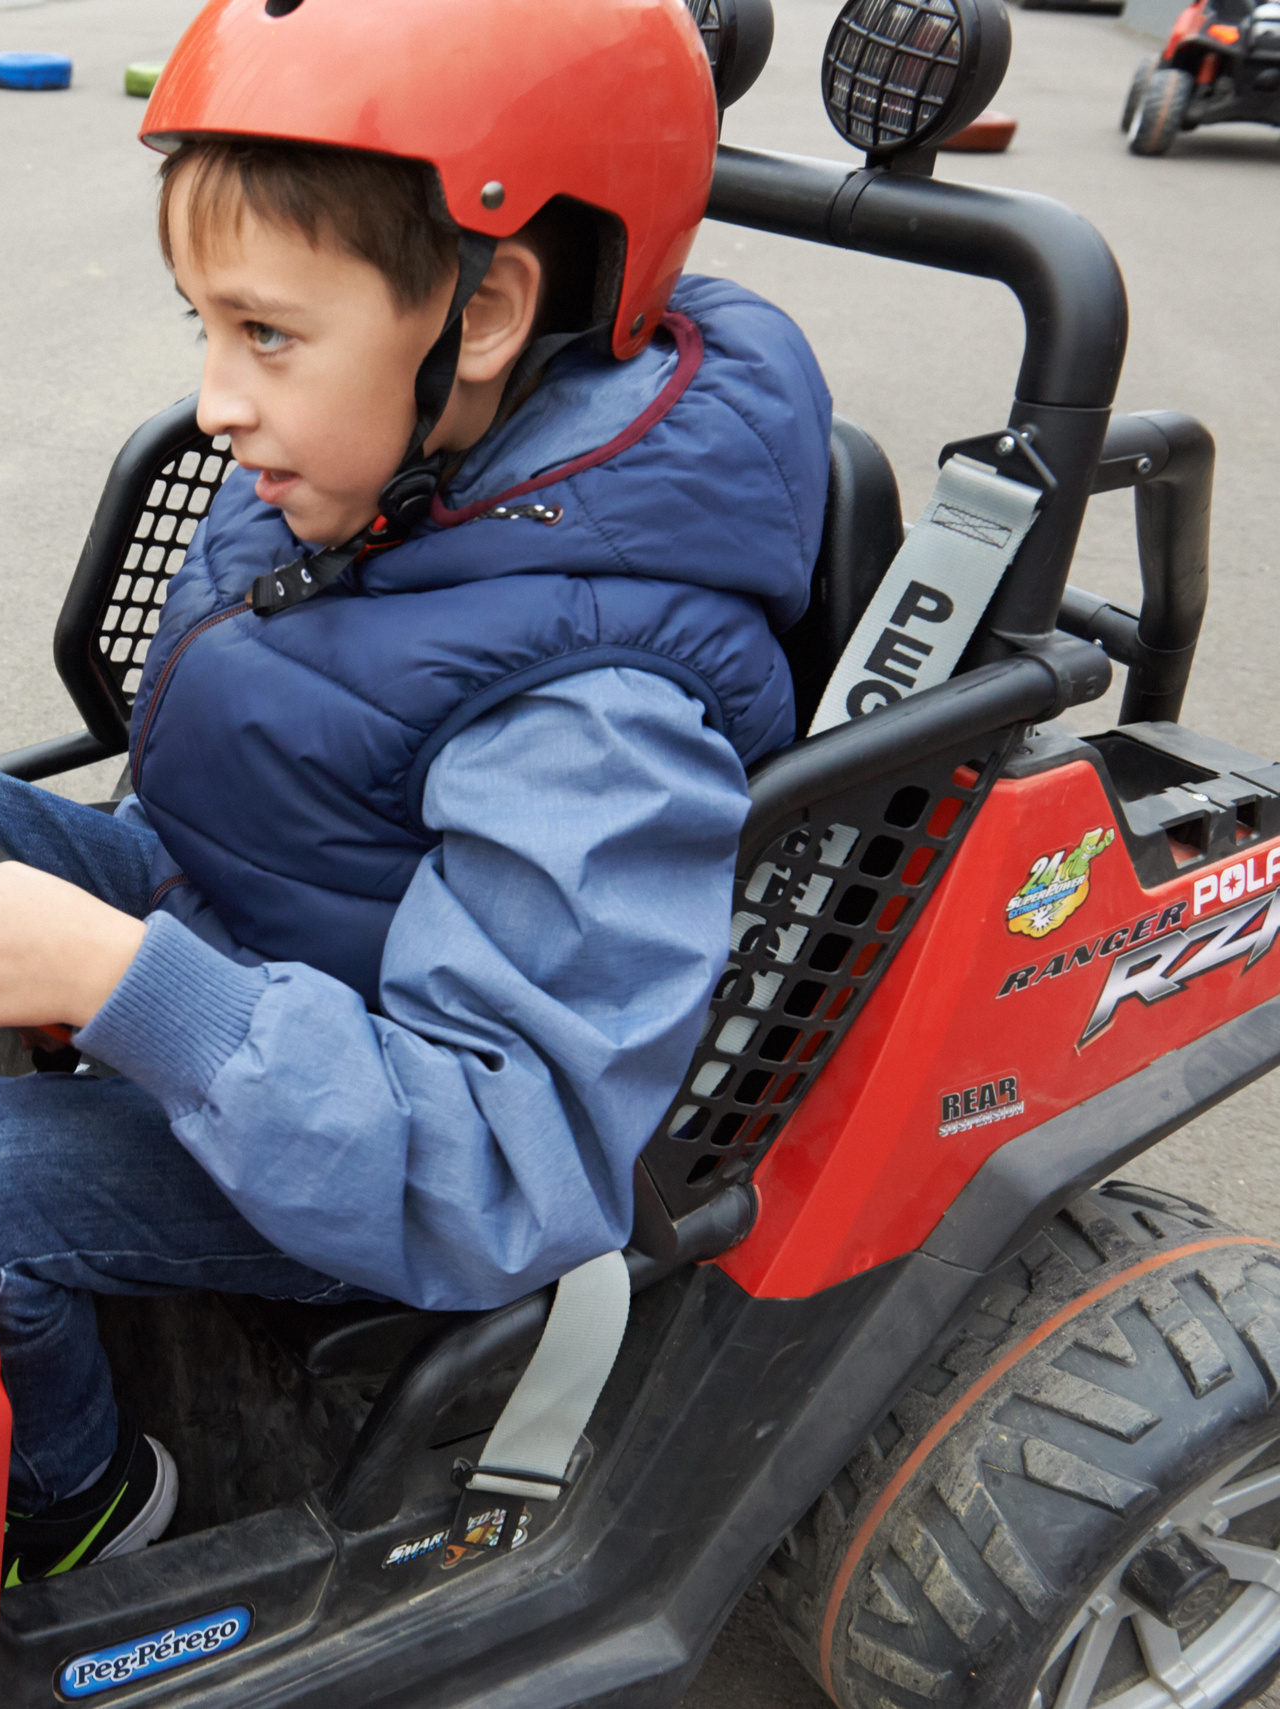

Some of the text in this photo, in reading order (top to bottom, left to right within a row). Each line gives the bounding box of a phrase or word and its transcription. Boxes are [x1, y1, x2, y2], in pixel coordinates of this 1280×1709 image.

[995, 901, 1188, 999] RANGER
[938, 1100, 1025, 1138] SUSPENSION
[942, 1076, 1018, 1123] REAR
[73, 1617, 240, 1690] Peg-Pérego
